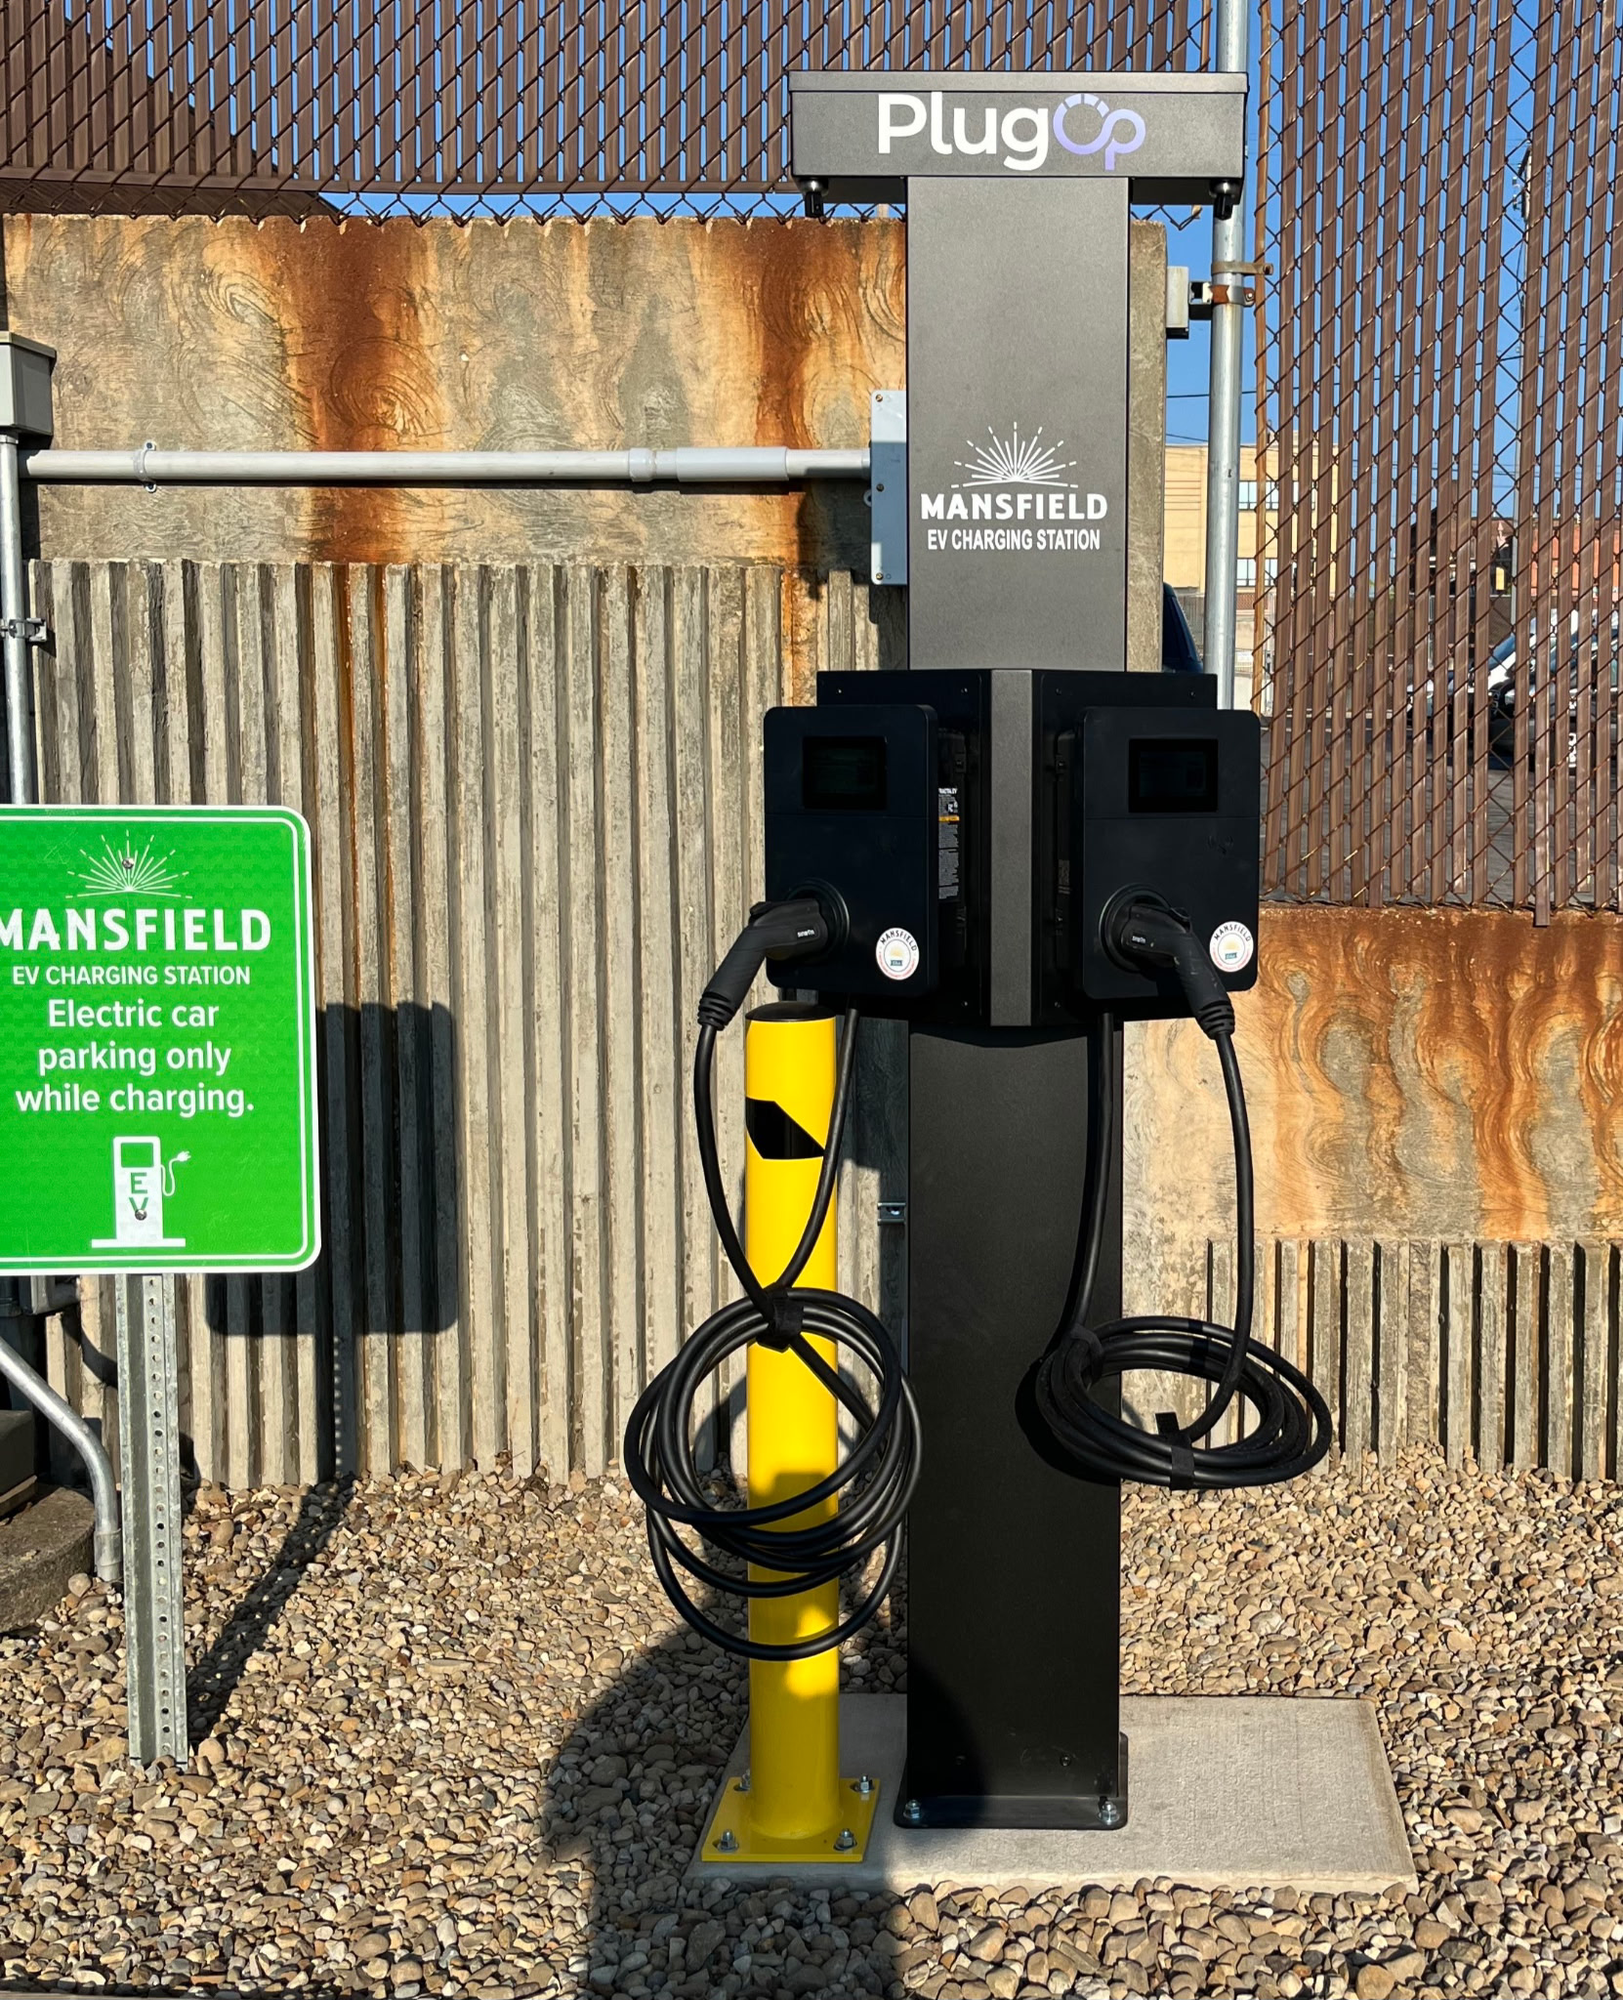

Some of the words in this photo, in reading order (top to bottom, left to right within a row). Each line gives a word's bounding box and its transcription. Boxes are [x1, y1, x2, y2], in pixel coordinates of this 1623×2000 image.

[920, 493, 1108, 520] MANSFIELD
[927, 529, 948, 550] EV
[951, 528, 1033, 550] CHARGING
[1036, 528, 1100, 550] STATION
[0, 908, 271, 951] MANSFIELD
[880, 929, 917, 951] MANSFIELD
[1214, 923, 1251, 942] MANSFIELD
[12, 965, 39, 985] EV
[45, 965, 158, 985] CHARGING
[163, 965, 251, 985] STATION
[48, 998, 163, 1028] Electric
[171, 1005, 220, 1028] car
[38, 1041, 156, 1077] parking
[166, 1041, 232, 1077] only
[15, 1082, 101, 1112] while
[109, 1083, 255, 1119] charging.
